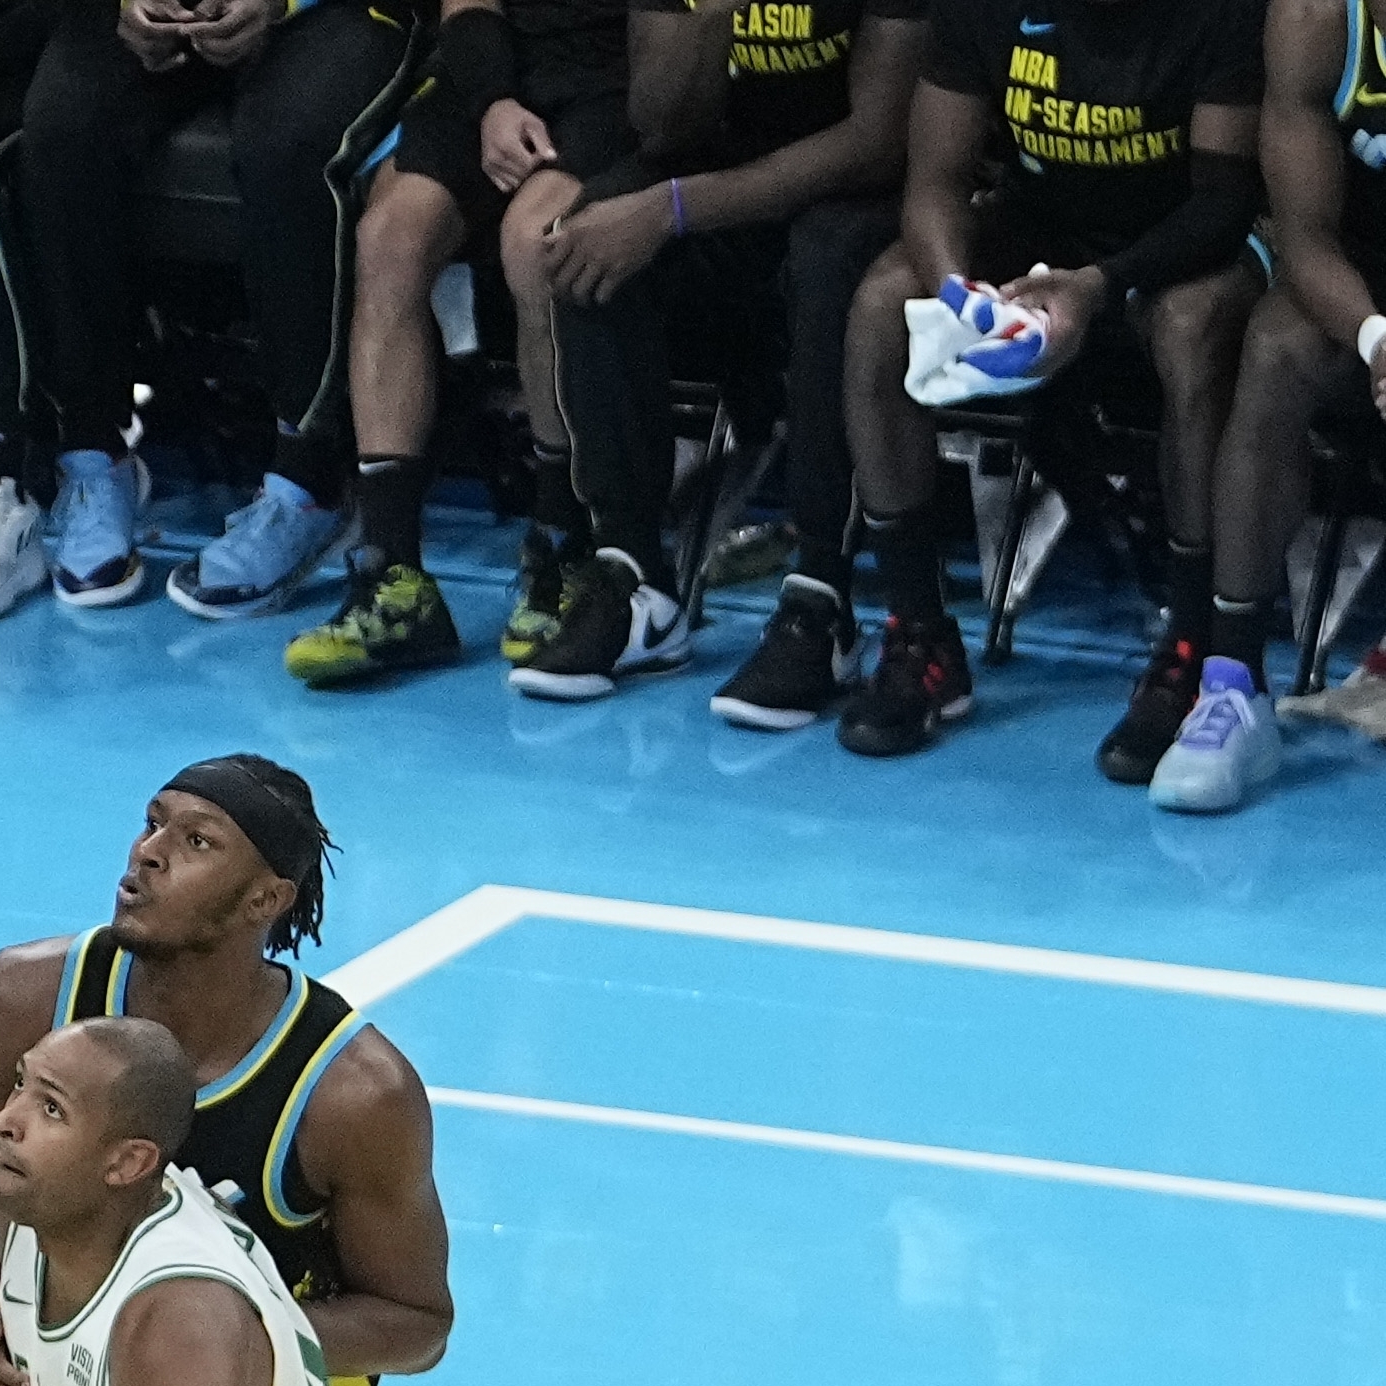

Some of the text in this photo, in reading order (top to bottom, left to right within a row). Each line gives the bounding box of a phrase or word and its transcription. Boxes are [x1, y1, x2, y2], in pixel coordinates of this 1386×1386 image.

[732, 2, 812, 39] EASON
[729, 29, 851, 74] RNAMENT
[1008, 45, 1057, 92] NBA
[1004, 86, 1142, 136] IN-SEASON
[1007, 125, 1181, 166] TOURNAMENT
